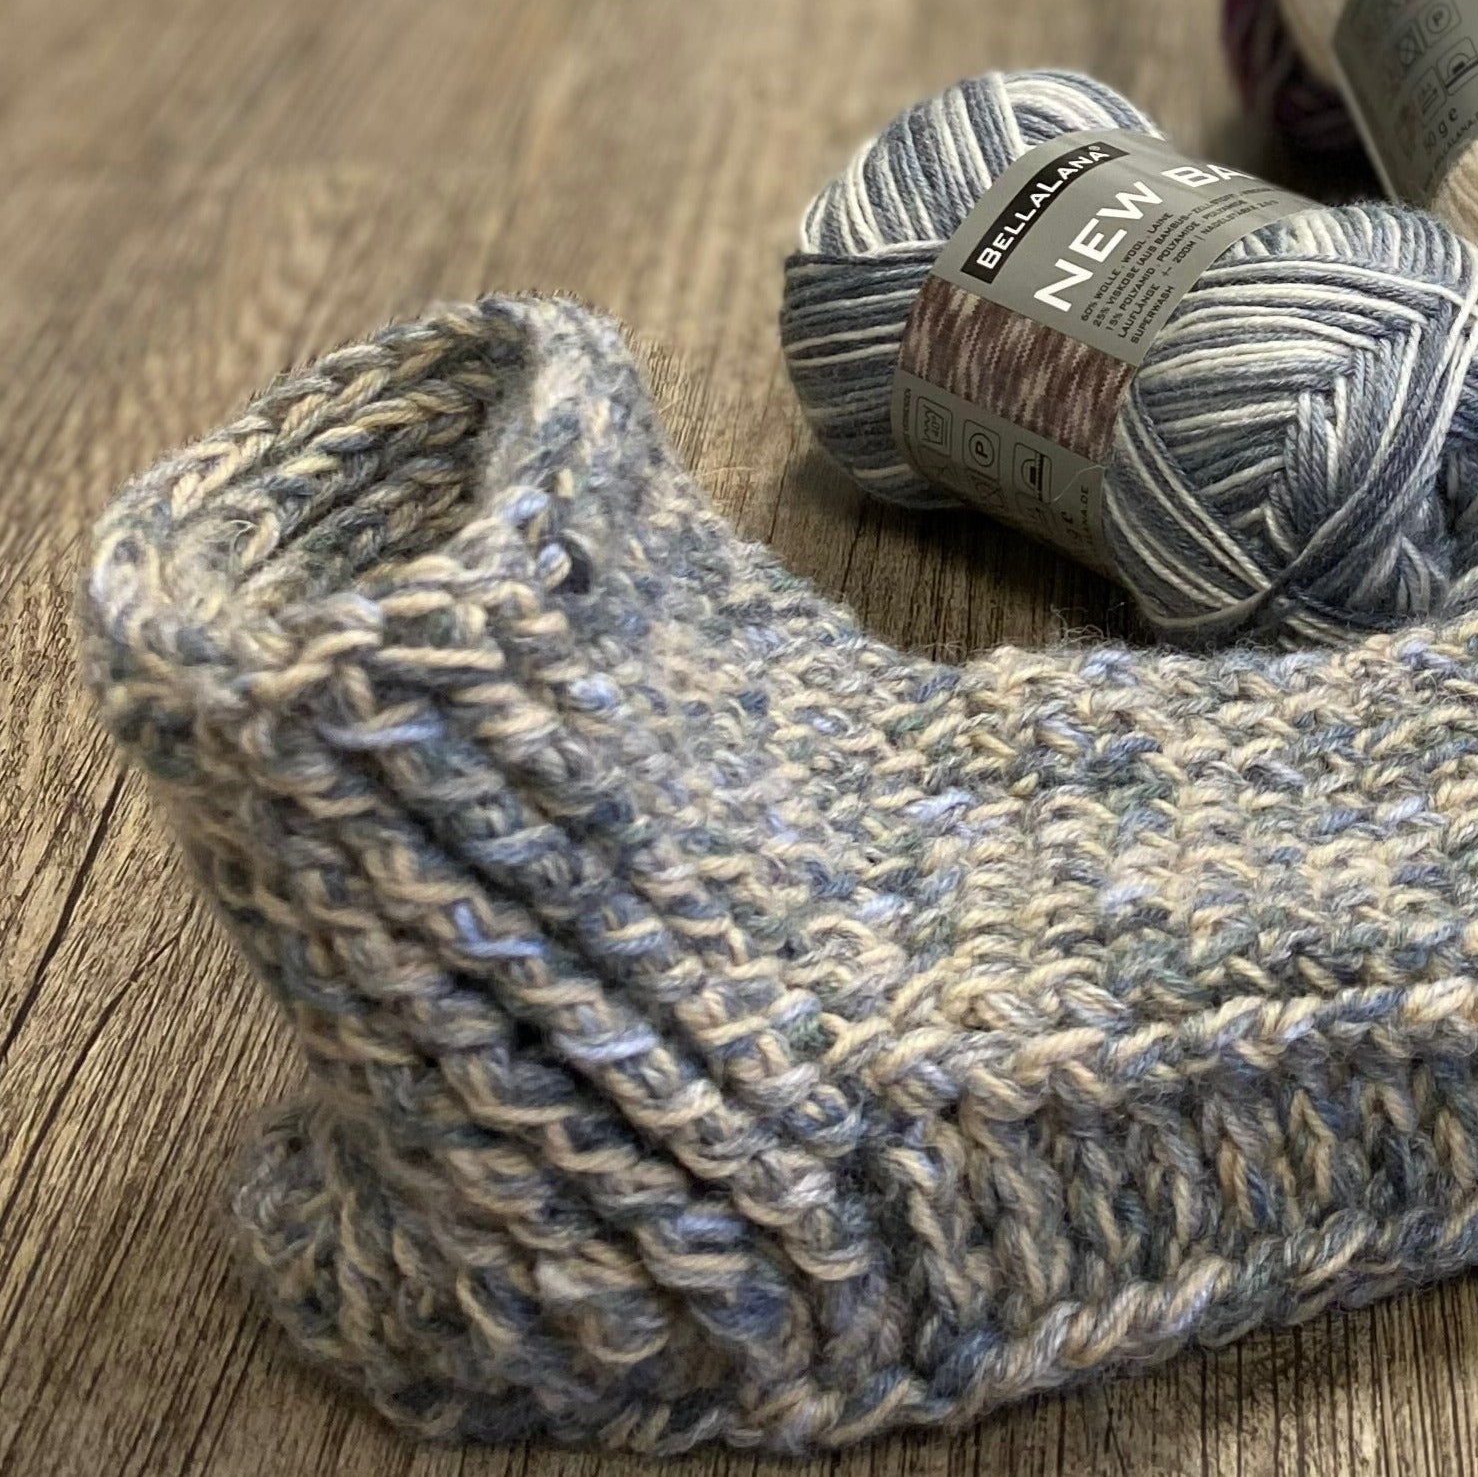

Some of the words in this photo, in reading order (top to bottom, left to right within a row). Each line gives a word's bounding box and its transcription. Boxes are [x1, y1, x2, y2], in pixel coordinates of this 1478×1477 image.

[1033, 180, 1164, 312] NEW
[1094, 268, 1122, 300] WOLLE
[1121, 240, 1147, 263] WOOL
[1147, 212, 1174, 234] LAINE
[1106, 266, 1140, 305] VISKOSE
[1118, 267, 1156, 311] POLYAMID
[1156, 221, 1200, 262] POLYAMIDE
[1130, 285, 1175, 344] SUPERWASH
